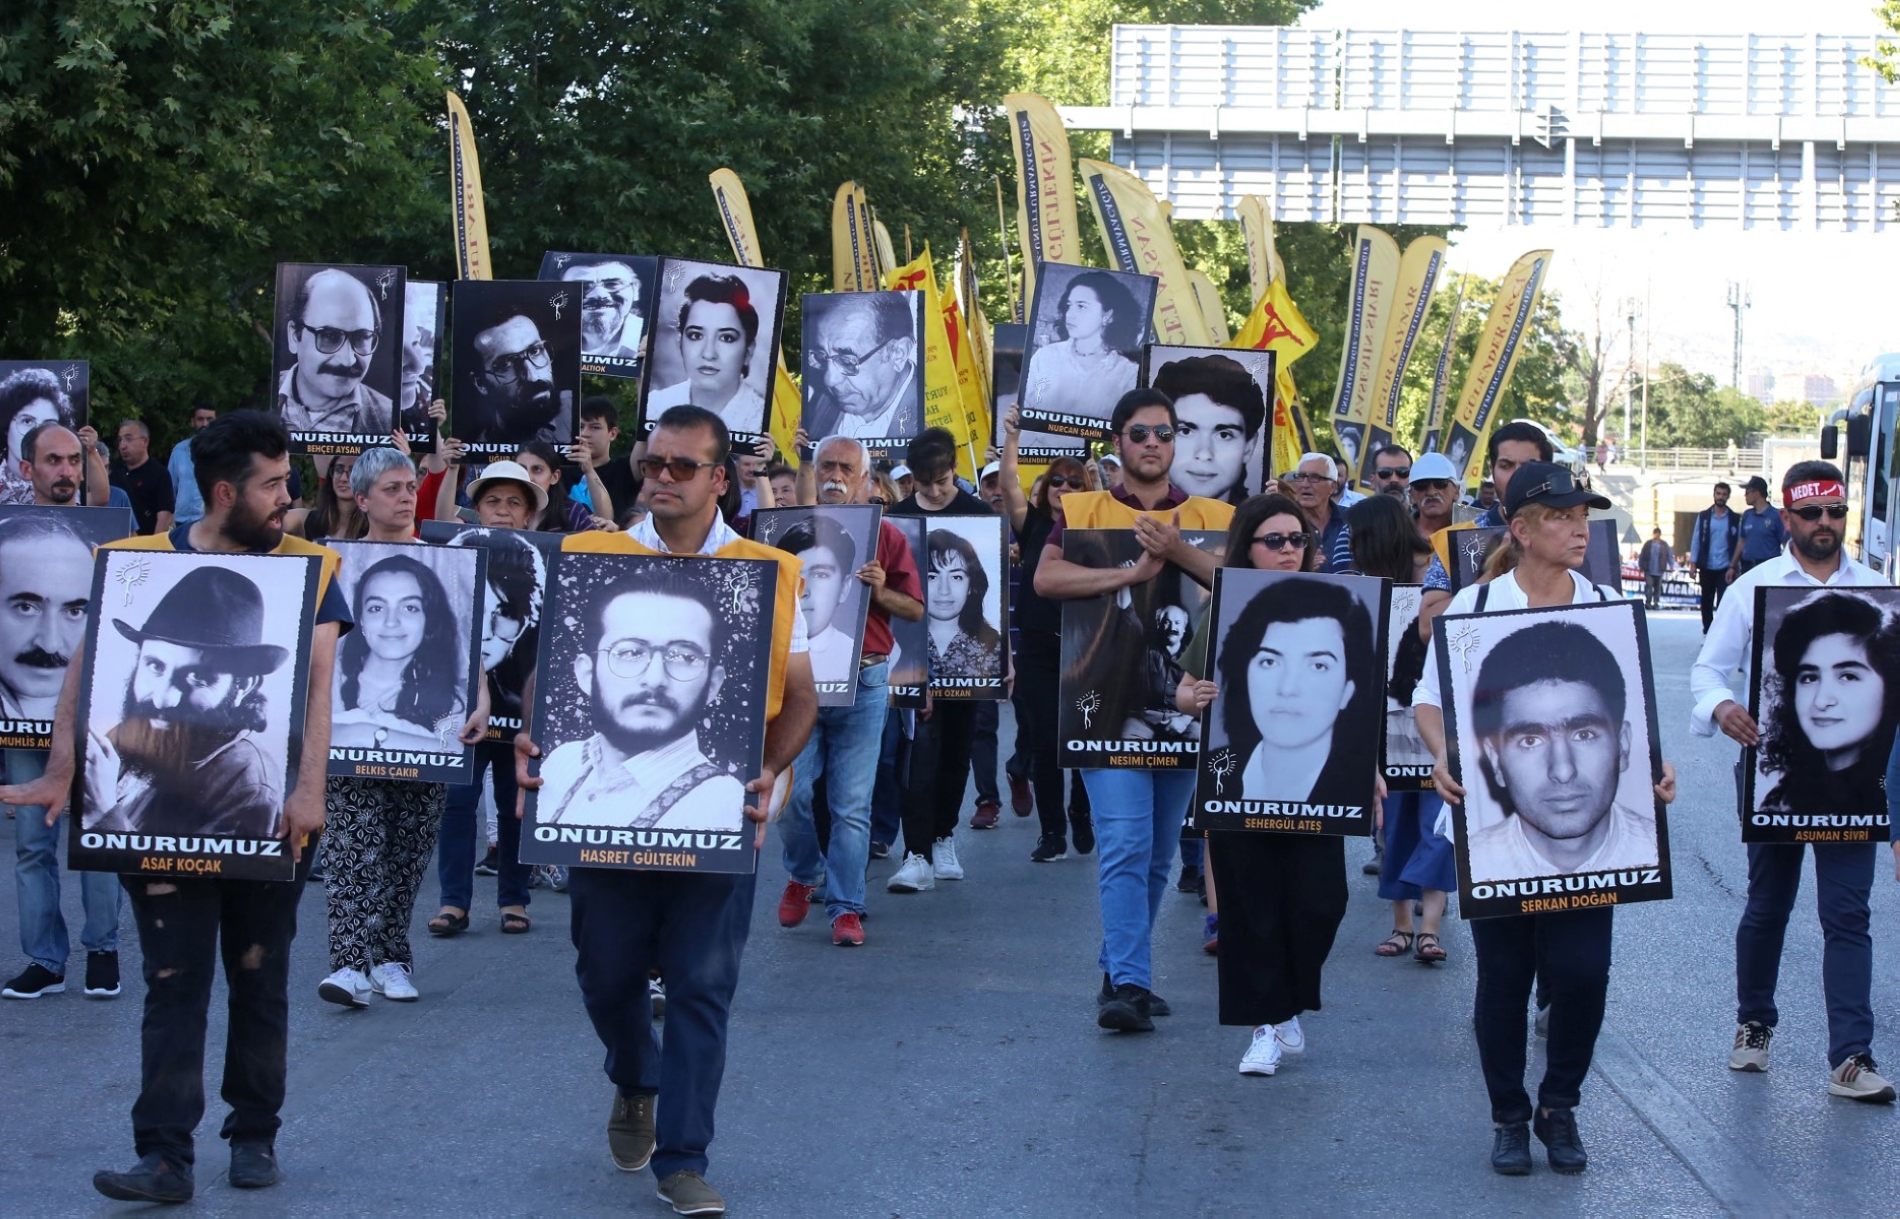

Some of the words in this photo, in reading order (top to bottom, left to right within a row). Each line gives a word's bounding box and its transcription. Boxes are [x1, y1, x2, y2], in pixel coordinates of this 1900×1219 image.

[1390, 286, 1418, 363] KAYNAR
[290, 432, 391, 445] NURUMUZ
[1047, 424, 1079, 434] NURCAN
[1080, 428, 1102, 439] ŞAHİN
[307, 445, 334, 455] BEHÇET
[335, 445, 361, 454] AYSAN
[869, 449, 888, 457] ZİRCİ
[997, 447, 1086, 457] OURUMUZ
[1790, 482, 1820, 501] MEDET
[930, 677, 1002, 688] RUMUZ
[945, 687, 971, 697] ÖZKAN
[0, 736, 35, 747] MUHLİS
[1067, 740, 1199, 753] ONURUMU
[329, 748, 464, 768] NURUMUZ
[1109, 754, 1143, 766] NESİMİ
[1146, 755, 1178, 768] ÇİMEN
[355, 765, 387, 776] BELKIS
[389, 766, 419, 780] ÇAKIR
[1204, 799, 1362, 819] ONURUMUZ
[1245, 816, 1296, 829] SEHERGÜL
[1297, 819, 1322, 833] ATEŞ
[1751, 814, 1890, 827] ONURUMU
[534, 826, 742, 850] ONURUMUZ
[1795, 830, 1840, 841] ASUMAN
[1843, 828, 1869, 840] SİVRİ
[81, 833, 282, 856] ONURUMUZ
[141, 856, 173, 871] ASAF
[177, 858, 222, 875] KOÇAK
[580, 849, 629, 864] HASRET
[633, 849, 696, 867] GÜLTEKİN
[1471, 868, 1661, 900] ONURUMUZ
[1521, 897, 1569, 914] SERKAN
[1571, 890, 1618, 907] DOĞAN
